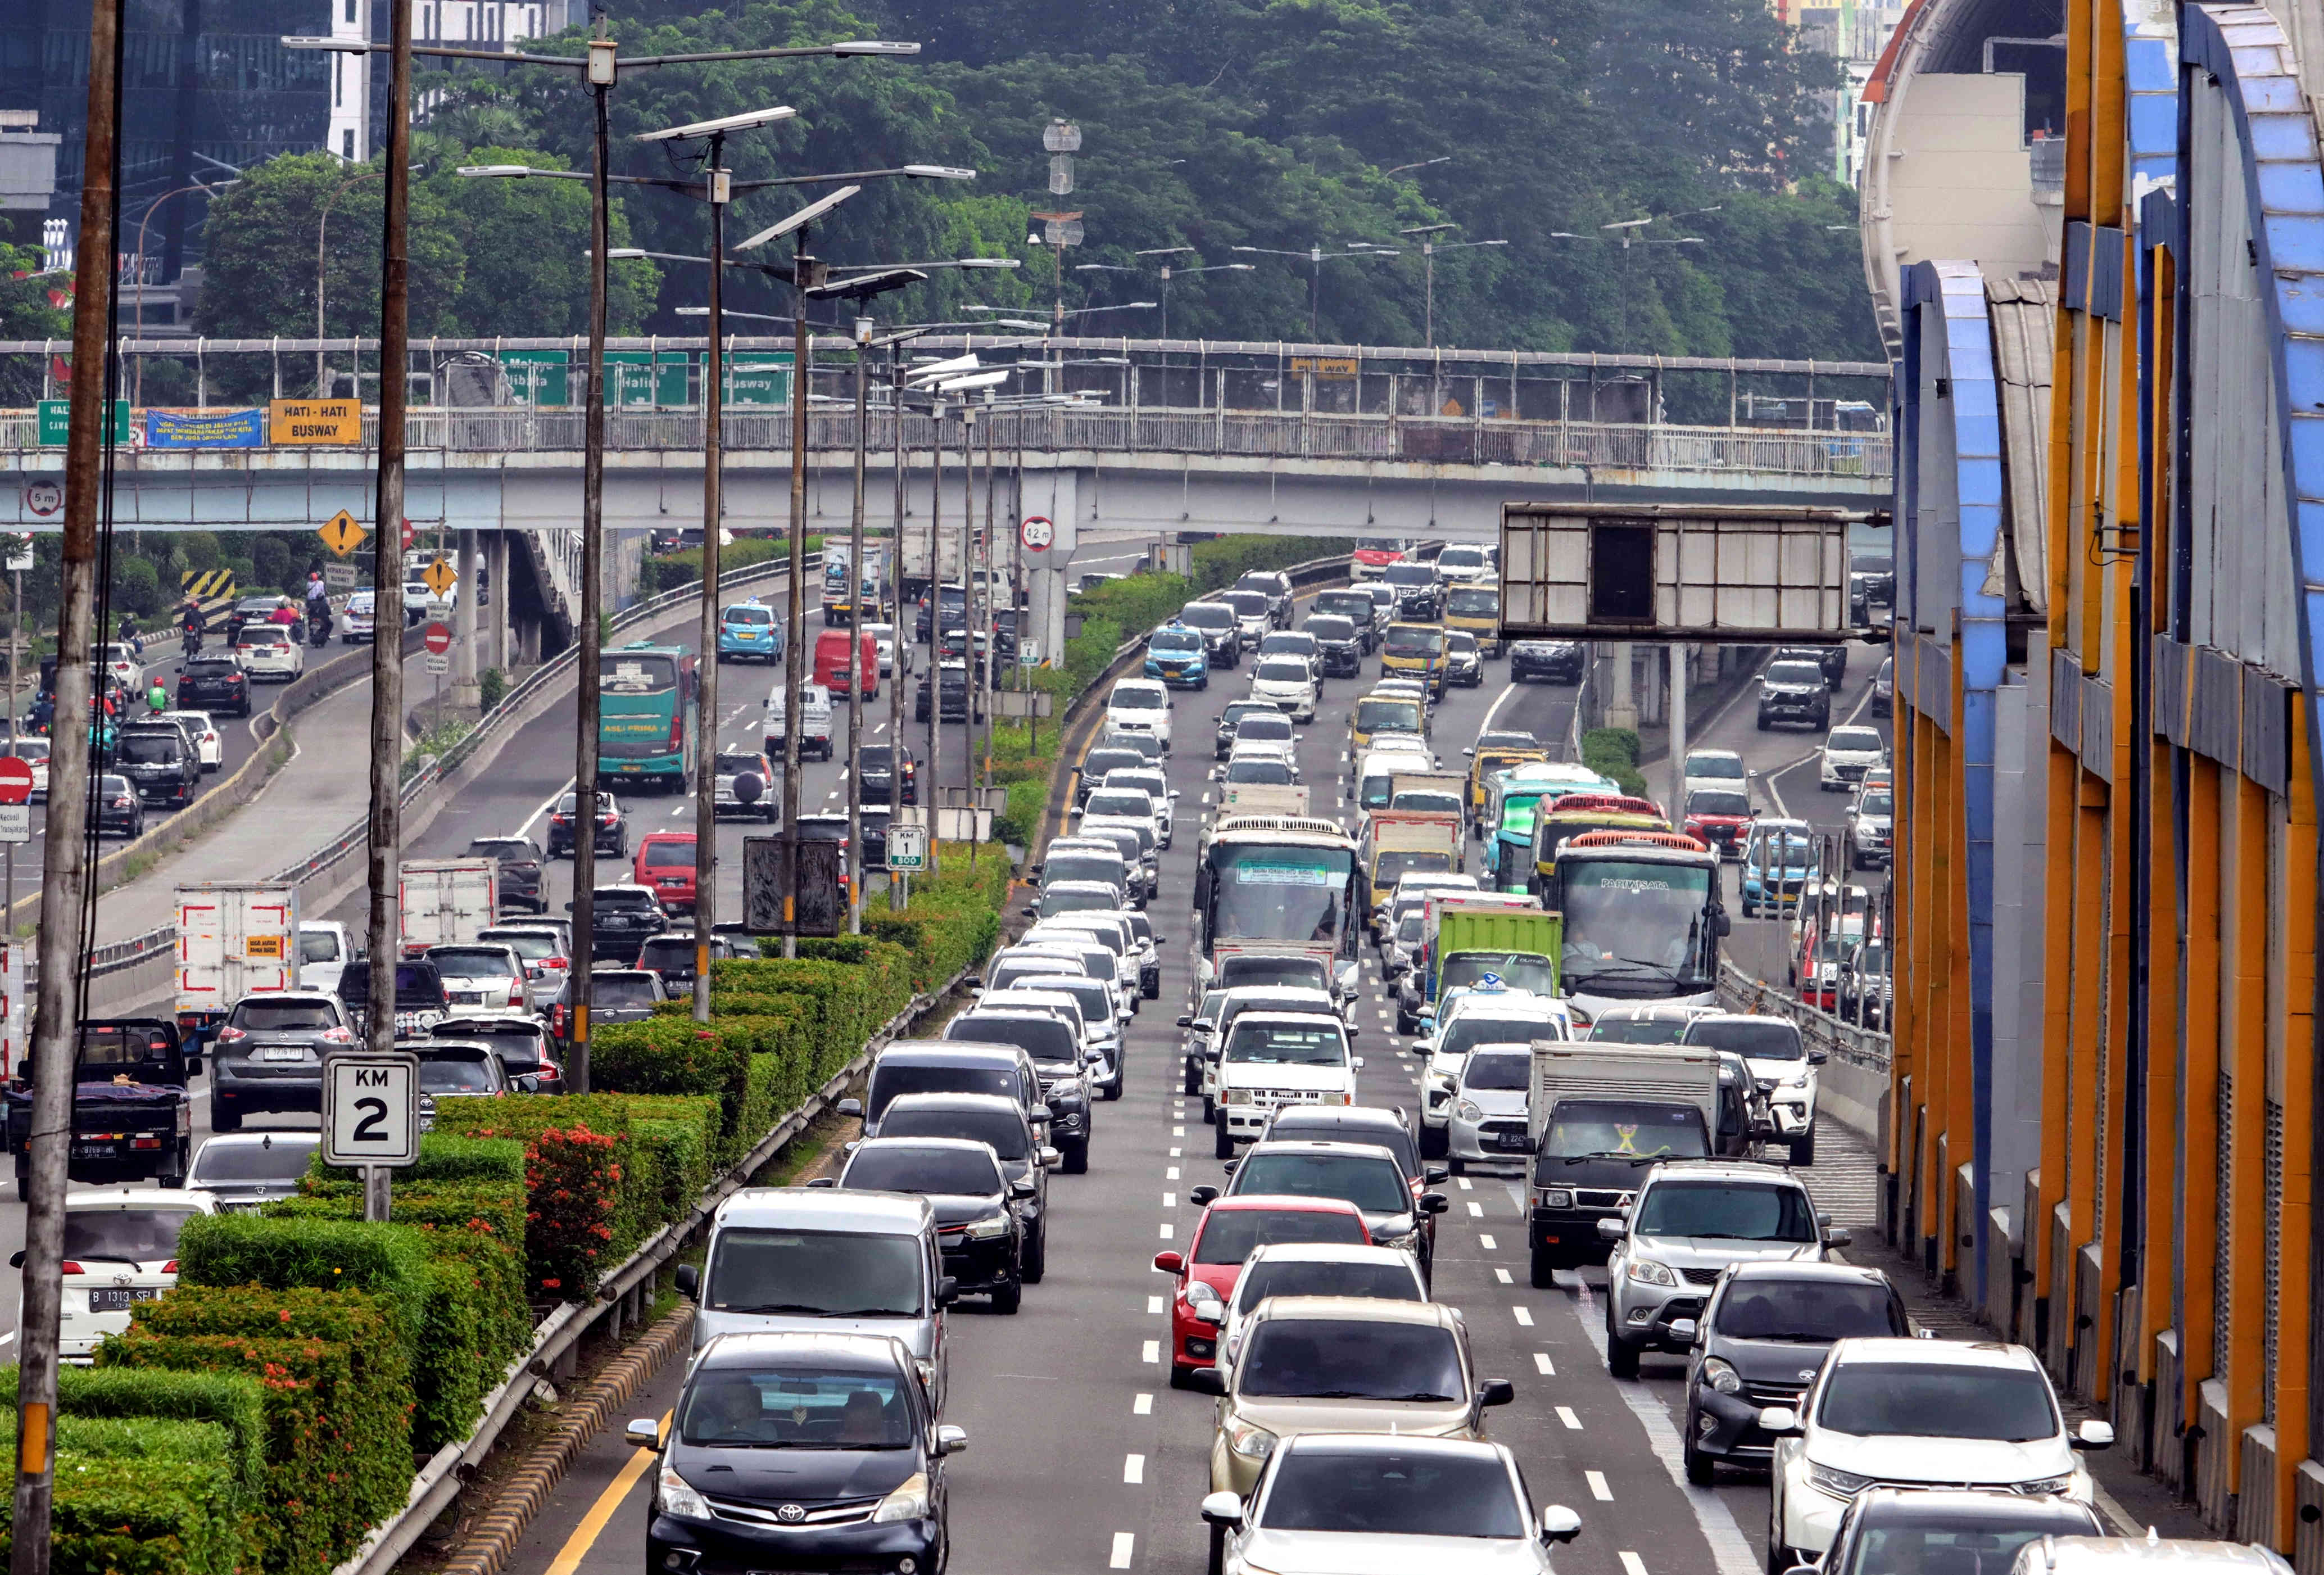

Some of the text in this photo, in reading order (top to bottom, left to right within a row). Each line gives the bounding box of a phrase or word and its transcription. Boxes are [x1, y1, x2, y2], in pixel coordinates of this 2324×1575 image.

[723, 378, 772, 391] Busway
[284, 406, 310, 417] HATI
[321, 406, 347, 417] HATI
[292, 425, 338, 437] BUSWAY
[904, 842, 908, 854] 1
[1601, 878, 1669, 890] PARIWISATA
[356, 1070, 388, 1087] KM
[354, 1097, 388, 1141] 2
[93, 1292, 99, 1302] B
